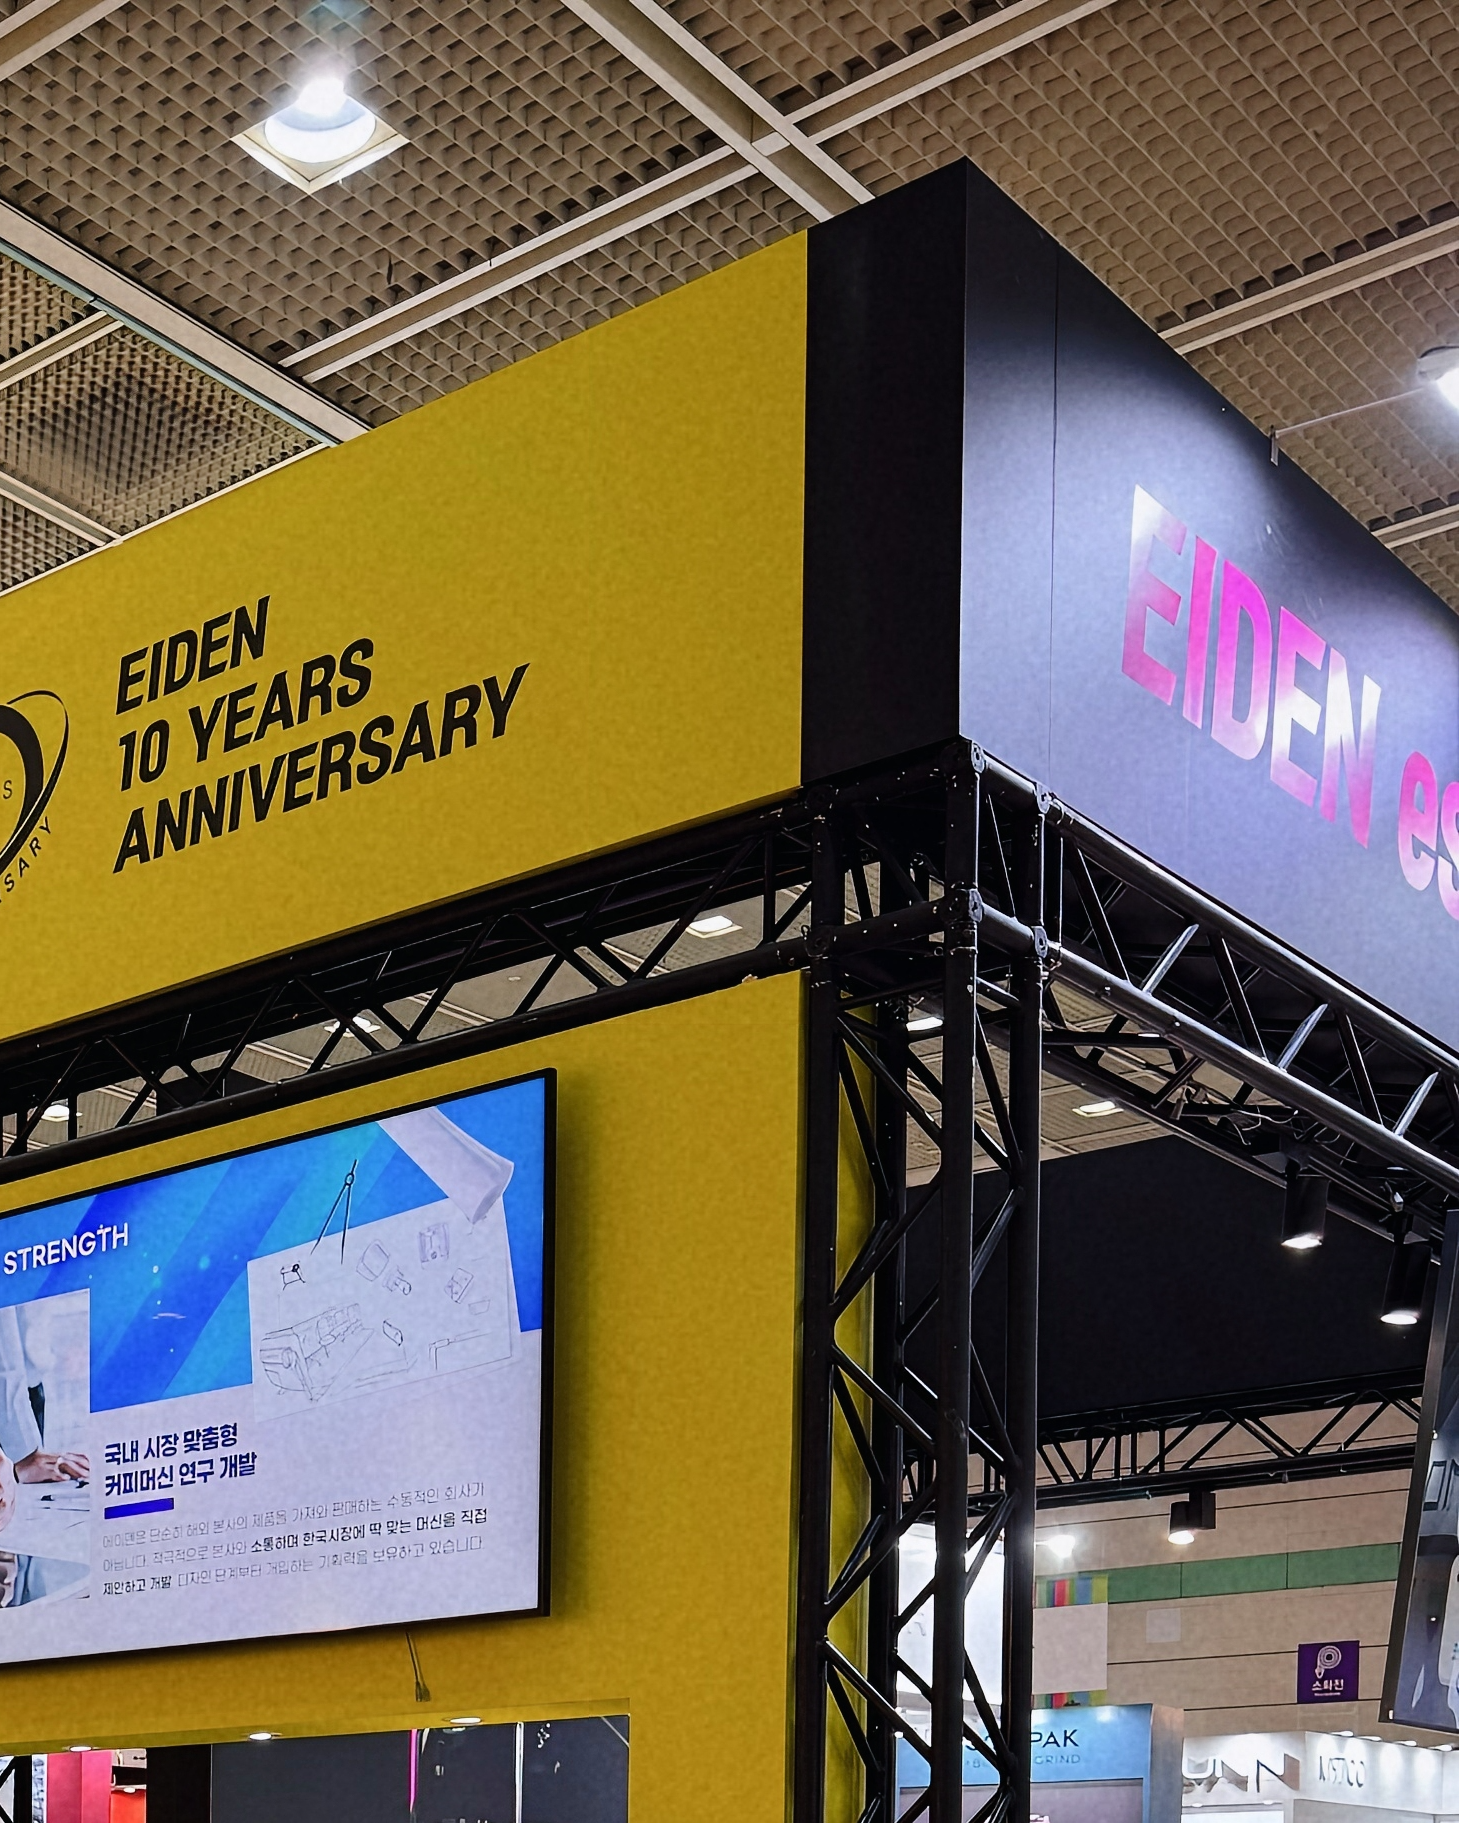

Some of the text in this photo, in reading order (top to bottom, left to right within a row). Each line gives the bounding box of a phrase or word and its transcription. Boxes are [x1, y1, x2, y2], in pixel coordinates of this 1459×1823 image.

[115, 594, 271, 715] EIDEN
[1121, 483, 1381, 849] EIDEN
[118, 637, 375, 792] 10 YEARS
[112, 662, 531, 875] ANNIVERSARY
[3, 1222, 129, 1275] STRENGTH
[105, 1422, 238, 1465] 국내 시장 맞춤형
[105, 1451, 258, 1497] 커피머신 연구 개발
[251, 1533, 298, 1553] 소통하며
[303, 1524, 365, 1547] 한국시장에
[369, 1522, 382, 1537] 딱
[386, 1519, 412, 1536] 맞는
[416, 1512, 455, 1531] 머신을
[461, 1508, 488, 1525] 직접
